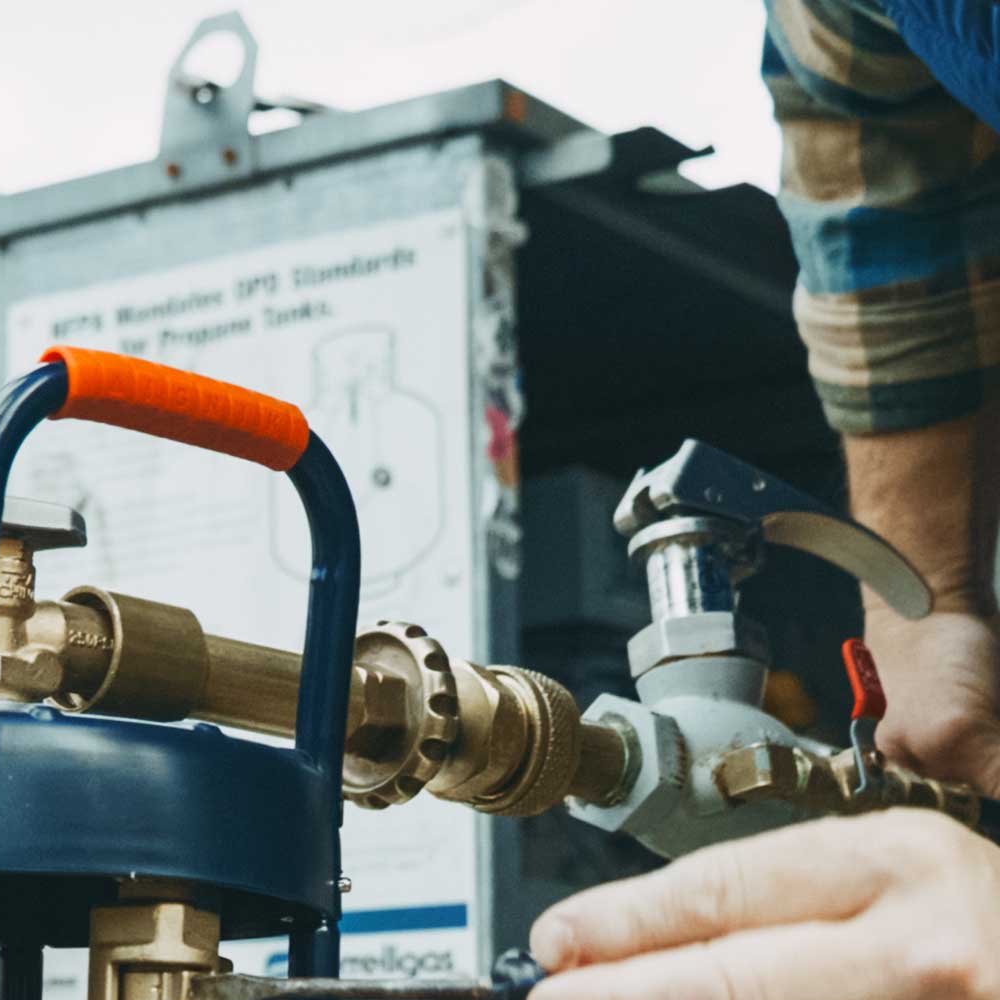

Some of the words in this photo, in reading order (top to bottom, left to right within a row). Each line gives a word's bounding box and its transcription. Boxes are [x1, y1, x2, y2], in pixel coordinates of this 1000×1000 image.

[117, 289, 223, 326] Mandates
[292, 249, 415, 286] Standards
[159, 317, 251, 349] Propane
